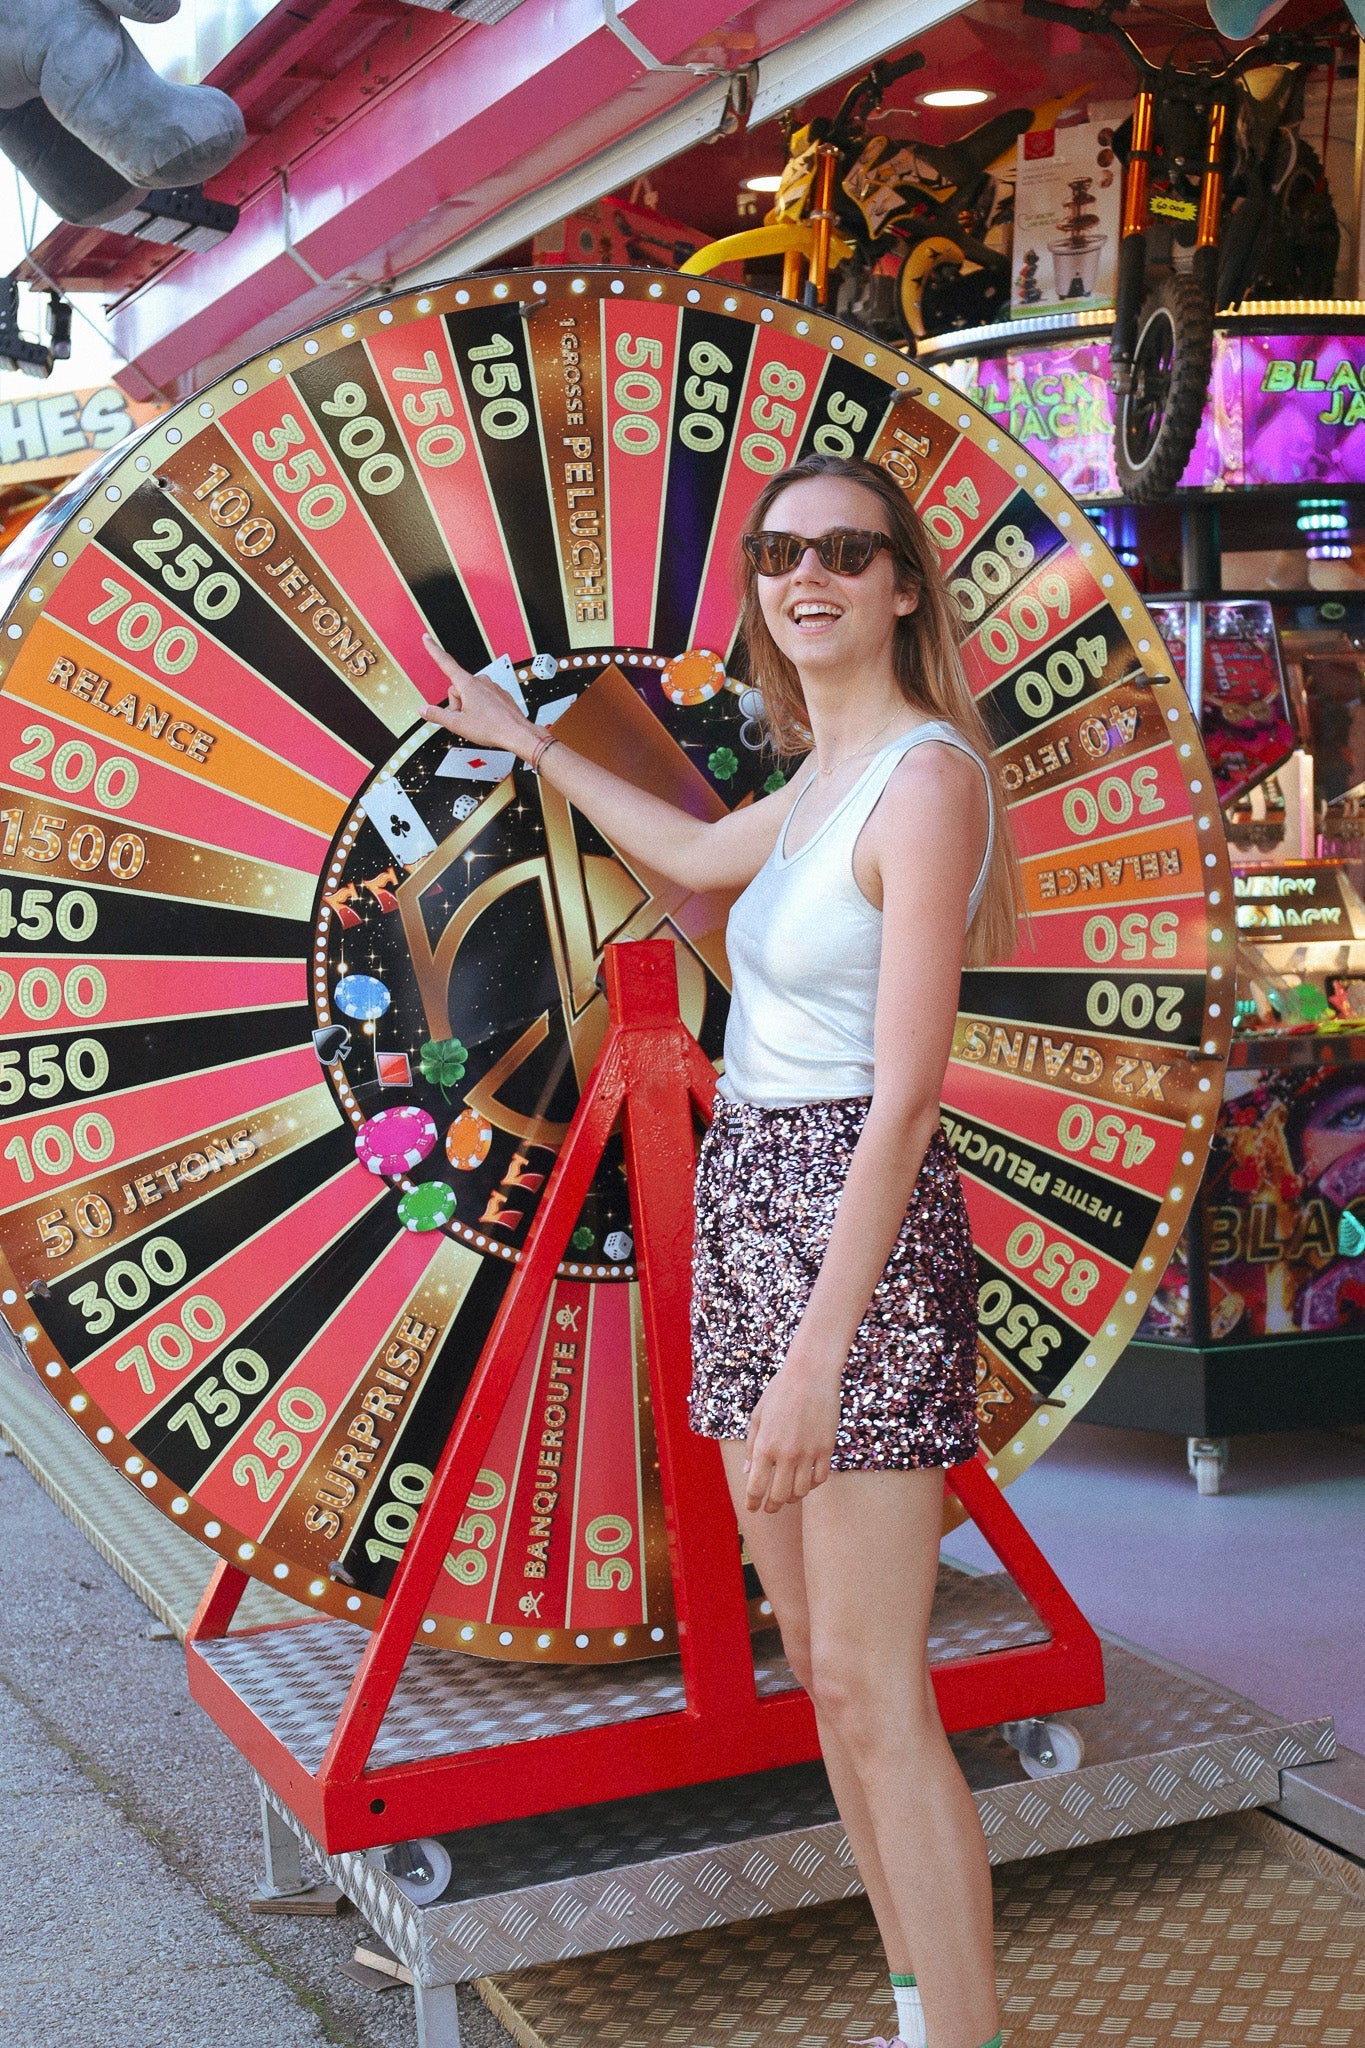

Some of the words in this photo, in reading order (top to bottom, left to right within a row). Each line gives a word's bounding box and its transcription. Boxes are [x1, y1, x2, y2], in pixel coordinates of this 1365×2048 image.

[558, 317, 577, 327] 1
[392, 350, 466, 469] 750
[467, 333, 529, 440] 150
[560, 331, 585, 426] GROSSE
[612, 332, 663, 455] 500
[679, 341, 733, 453] 650
[740, 361, 806, 476] 850
[1261, 360, 1365, 392] BLA
[251, 413, 347, 530] 350
[321, 381, 405, 495] 900
[879, 427, 933, 490] 10
[132, 518, 241, 621] 250
[191, 463, 279, 559] 100
[264, 555, 380, 678] JETONS
[562, 435, 607, 622] PELUCHE
[950, 524, 1035, 622] 800
[86, 577, 198, 676] 700
[979, 573, 1071, 665] 600
[46, 655, 216, 764] RELANCE
[1014, 634, 1109, 719] 400
[9, 724, 141, 809] 200
[1079, 705, 1138, 758] 40
[0, 808, 146, 880] 1500
[1062, 765, 1166, 836] 300
[1037, 848, 1182, 898] RELANCE
[1082, 911, 1180, 964] 550
[962, 1022, 1104, 1086] GAINS
[1086, 980, 1186, 1032] 200
[1113, 1053, 1172, 1102] X2
[4, 1112, 115, 1183] 100
[1057, 1103, 1157, 1169] 450
[35, 1192, 114, 1258] 50
[121, 1128, 259, 1216] JETONS
[1050, 1177, 1113, 1223] PETITE
[1112, 1210, 1125, 1228] 1
[67, 1236, 188, 1335] 300
[1005, 1220, 1100, 1307] 850
[114, 1294, 226, 1395] 700
[977, 1279, 1062, 1372] 350
[167, 1347, 270, 1450] 750
[232, 1386, 327, 1502] 250
[303, 1315, 440, 1541] SURPRISE
[523, 1340, 578, 1579] BANQUEROUTE
[365, 1462, 434, 1563] 100
[443, 1468, 506, 1586] 650
[585, 1514, 633, 1591] 50
